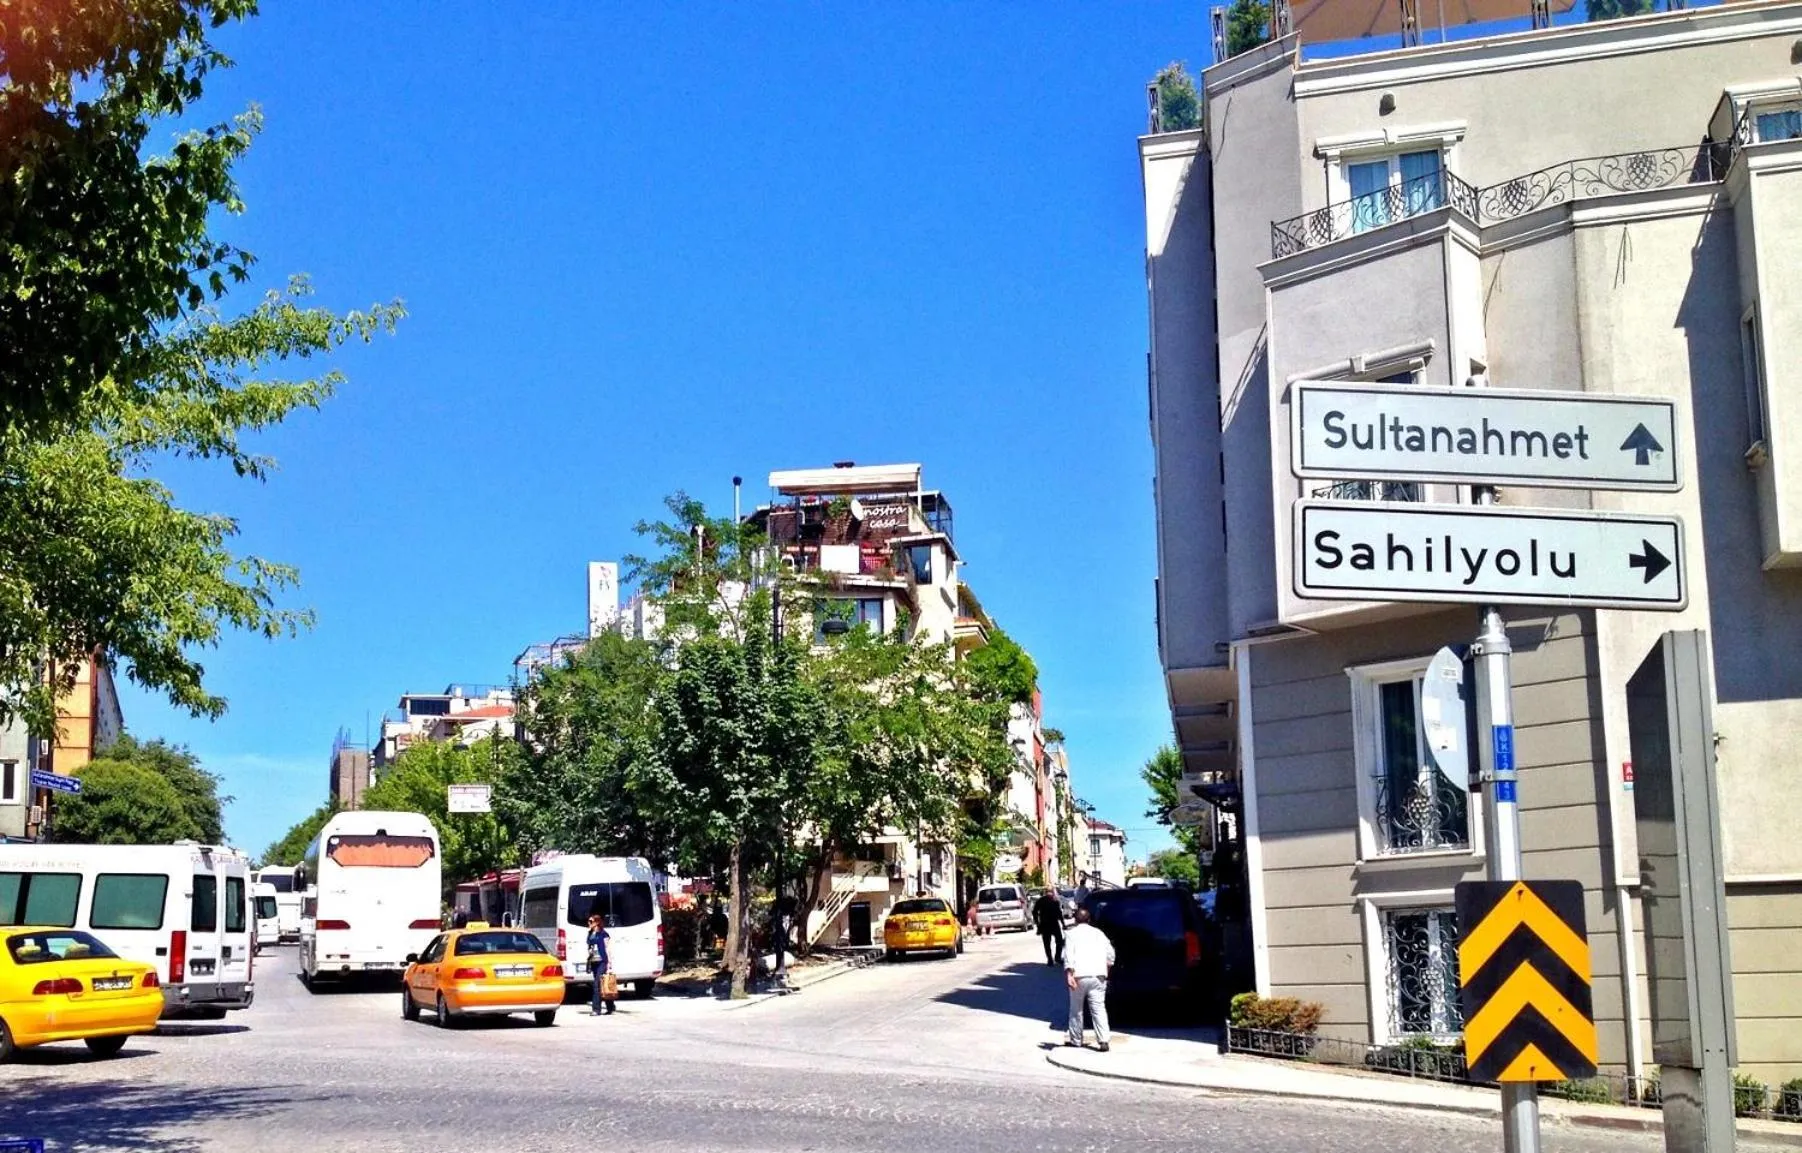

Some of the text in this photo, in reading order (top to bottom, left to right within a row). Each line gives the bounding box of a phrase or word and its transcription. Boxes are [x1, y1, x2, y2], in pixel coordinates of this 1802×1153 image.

[1323, 410, 1589, 459] Sultanahmet
[863, 504, 907, 517] nostra
[870, 518, 900, 529] casa
[1314, 530, 1577, 585] Sahilyolu
